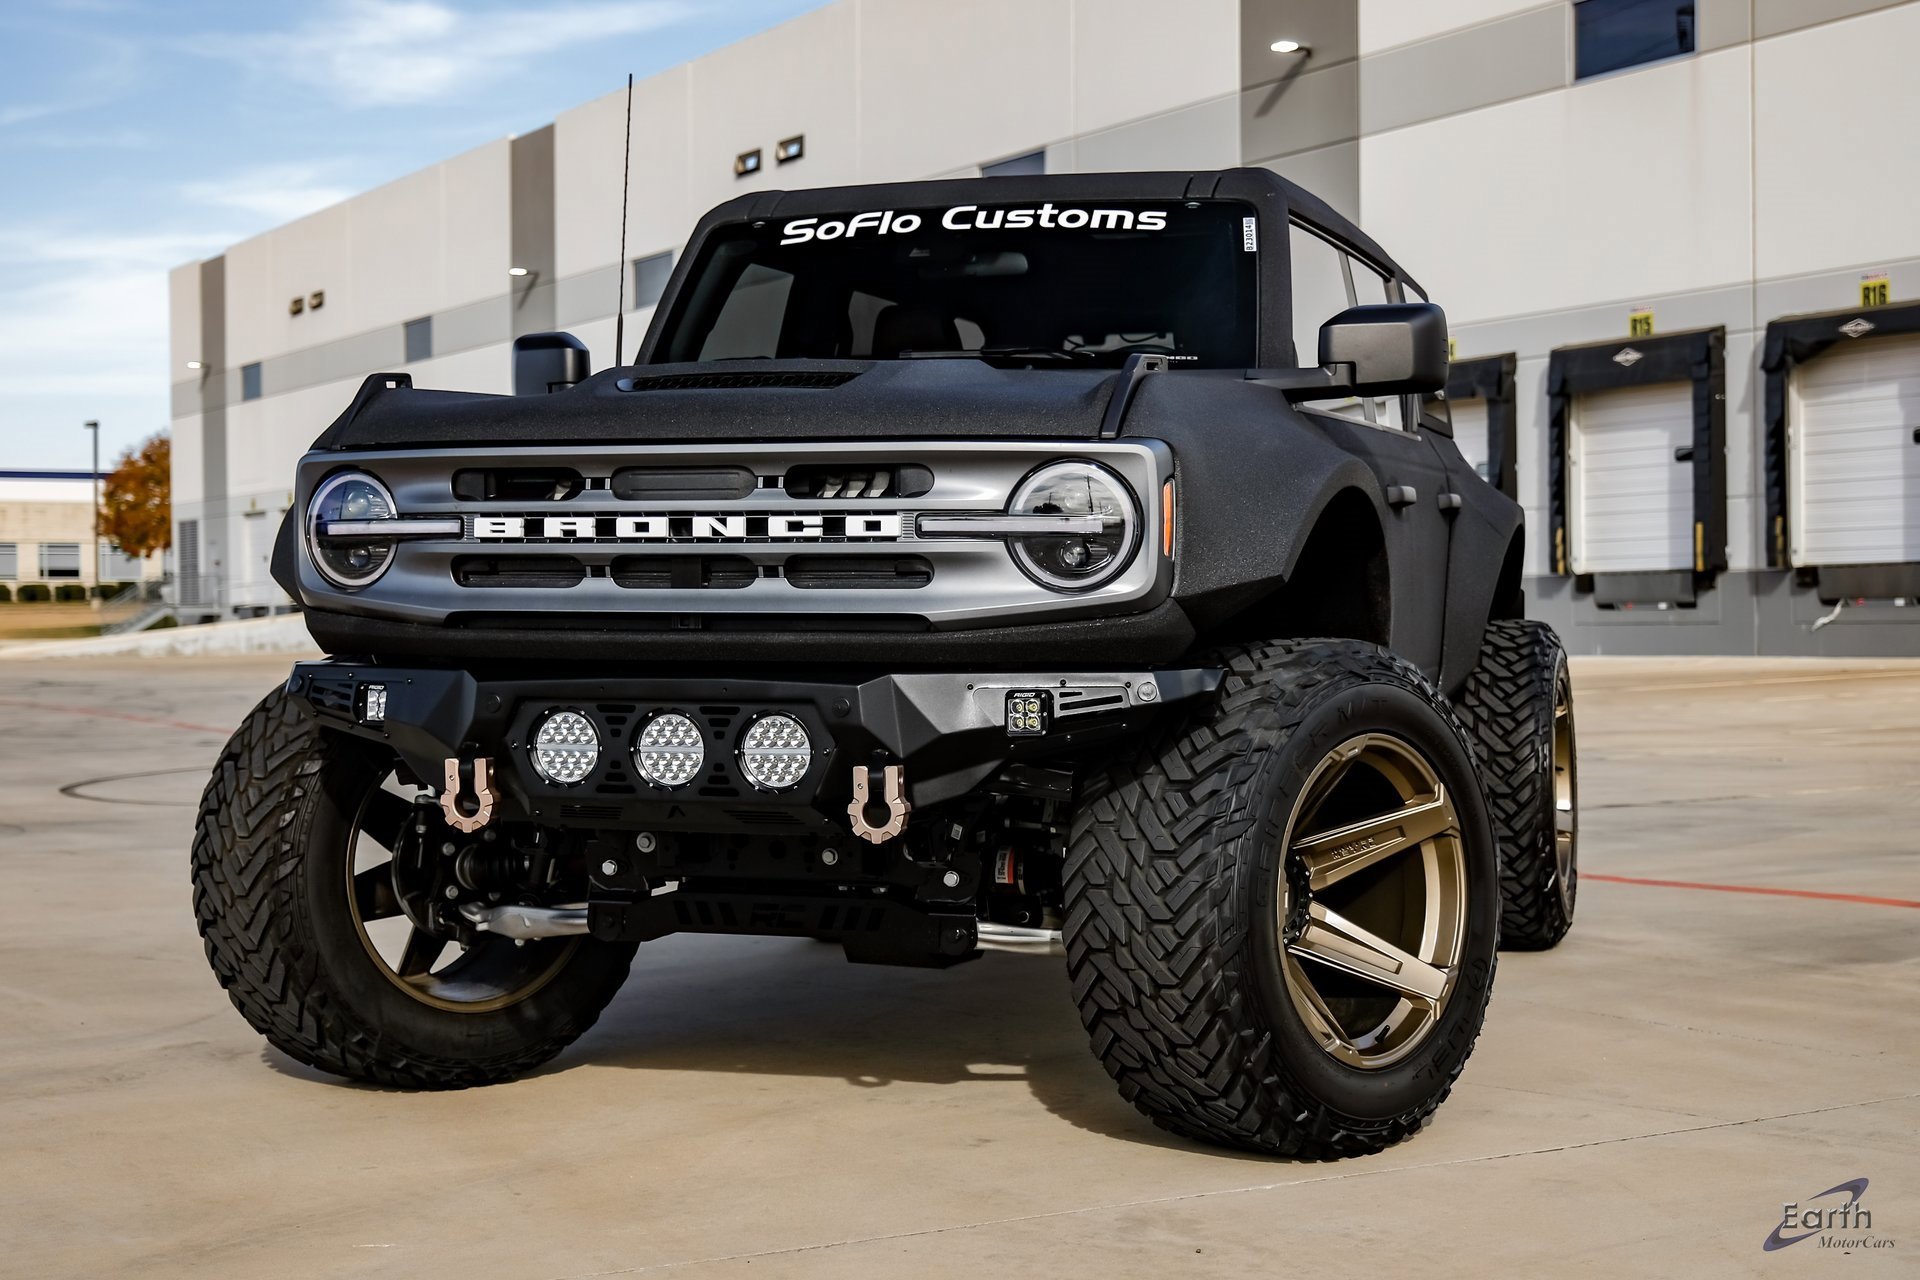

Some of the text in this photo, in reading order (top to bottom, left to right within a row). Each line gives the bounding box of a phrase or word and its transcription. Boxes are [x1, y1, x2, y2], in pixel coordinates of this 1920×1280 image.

[779, 203, 1167, 245] SoFlo Customs
[473, 514, 902, 539] BRONCO
